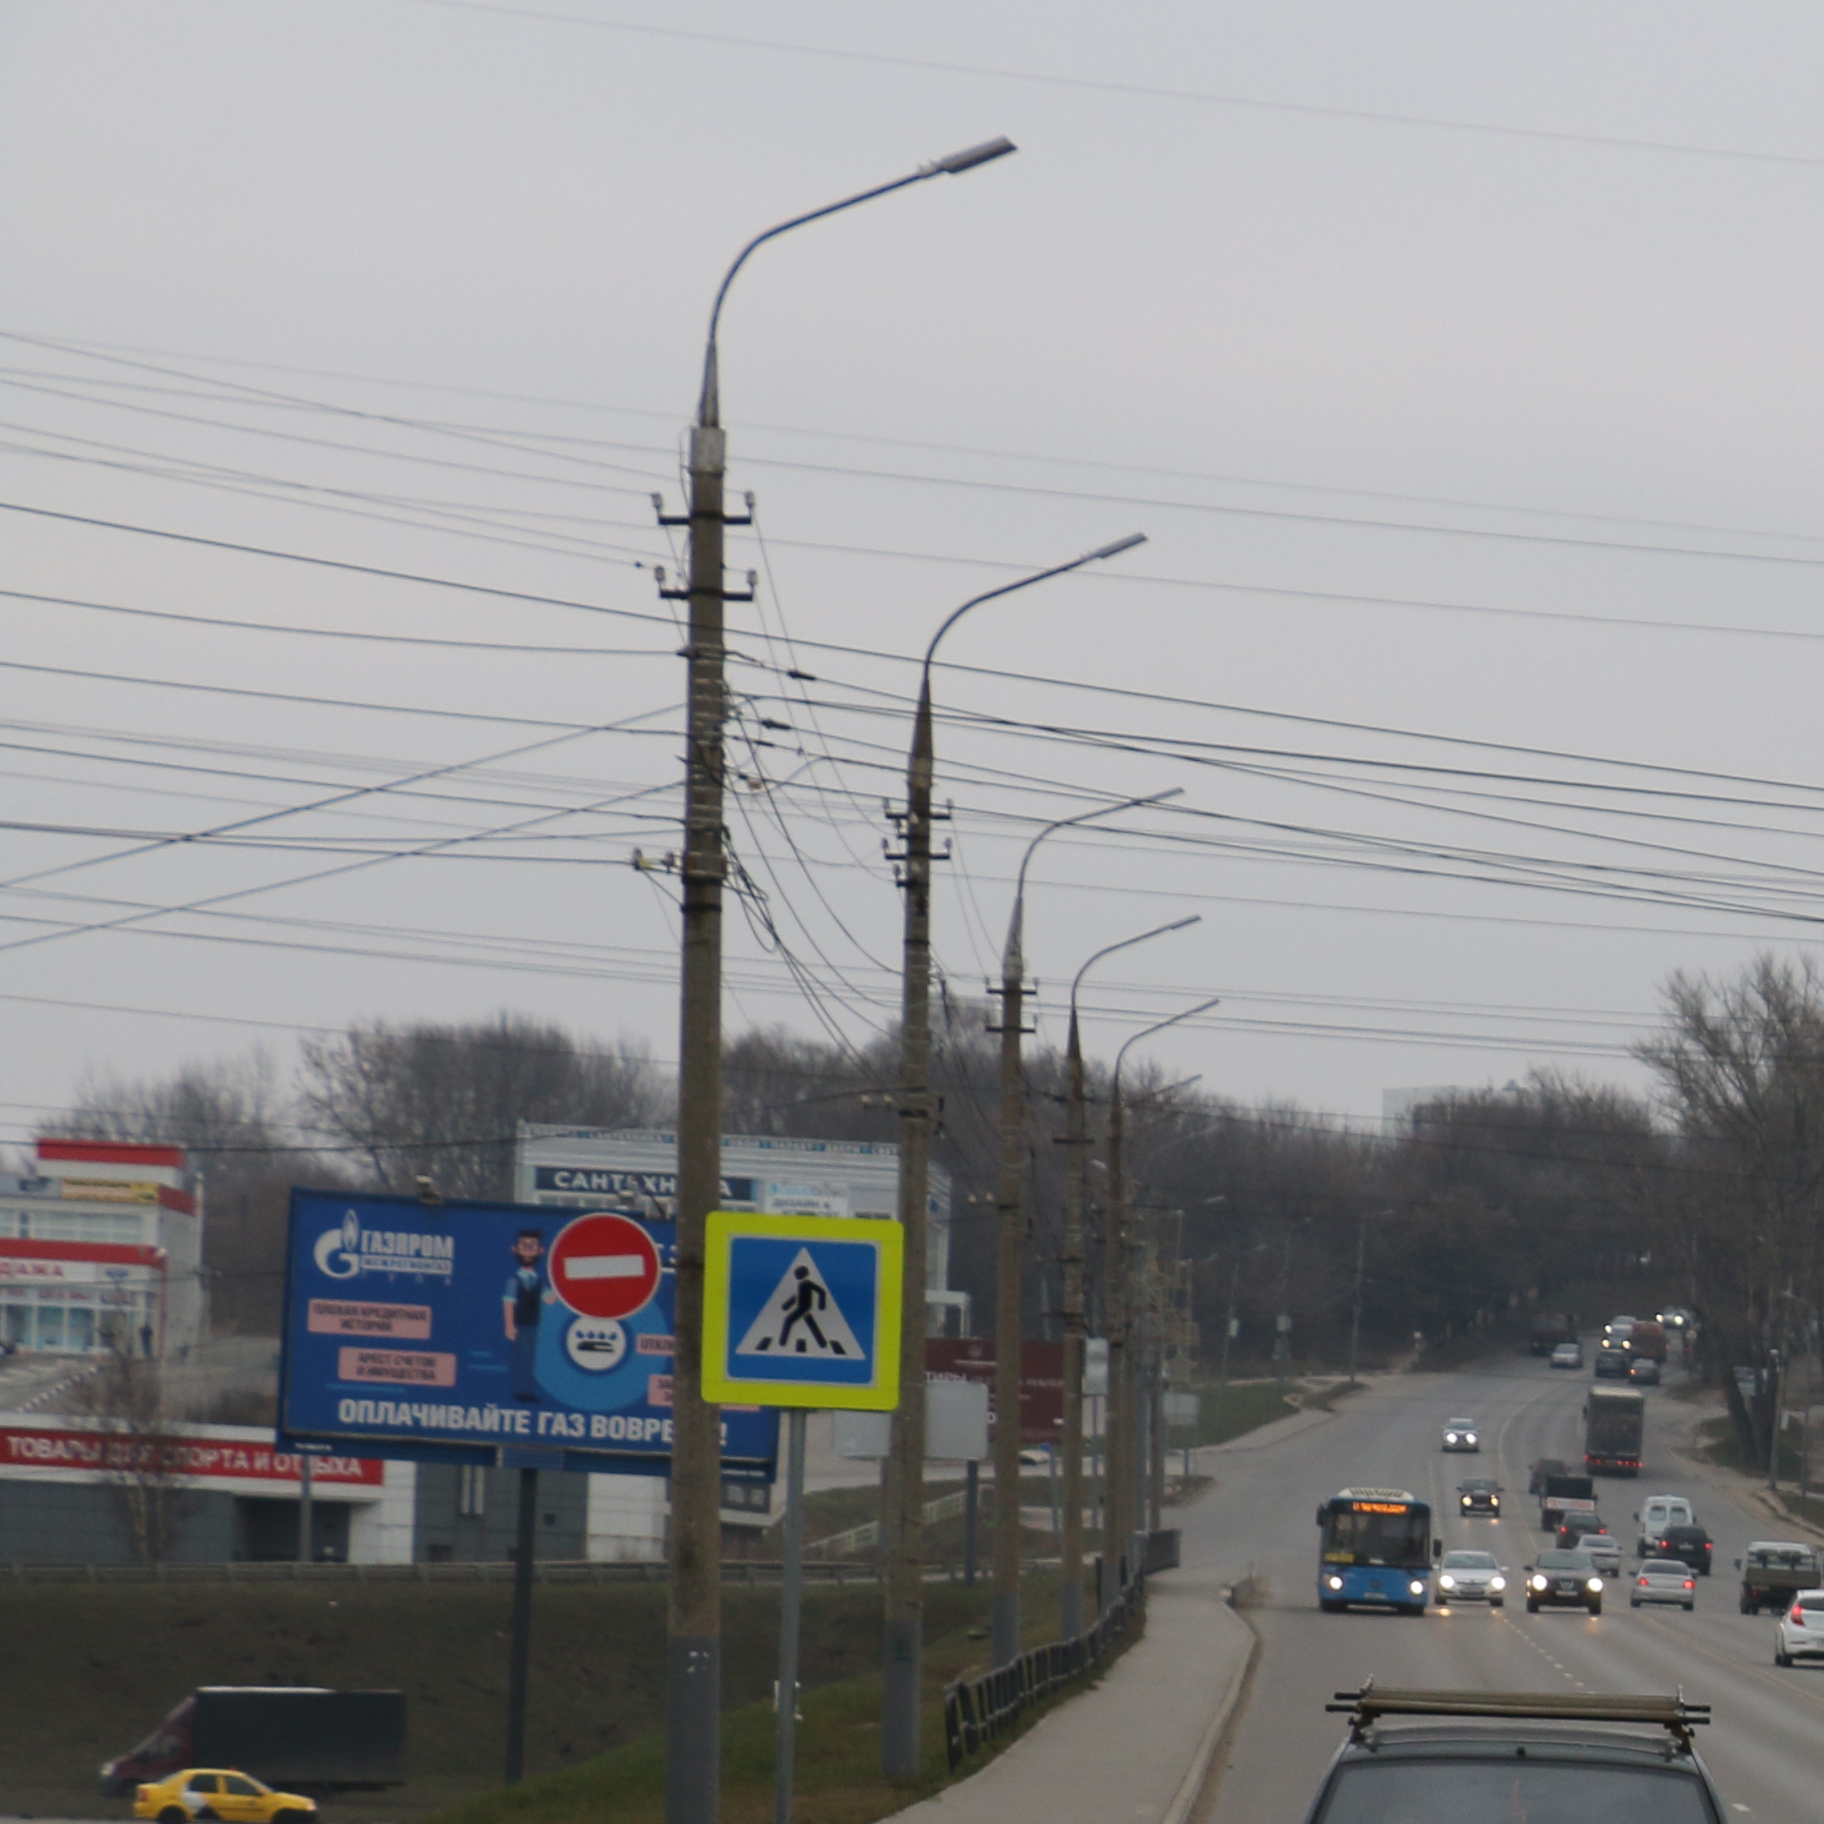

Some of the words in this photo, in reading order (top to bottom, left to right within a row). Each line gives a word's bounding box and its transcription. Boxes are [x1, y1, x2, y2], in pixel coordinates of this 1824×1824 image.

[554, 1171, 732, 1198] САНТЕХНА
[361, 1230, 455, 1259] ГАЗПРОМ
[339, 1398, 530, 1434] ОПЛАЧИВАЙТЕ
[537, 1411, 586, 1437] ГАЗ
[589, 1415, 728, 1445] ВОВРЕ!
[254, 1451, 269, 1472] И
[272, 1452, 364, 1478] ОТЫХА
